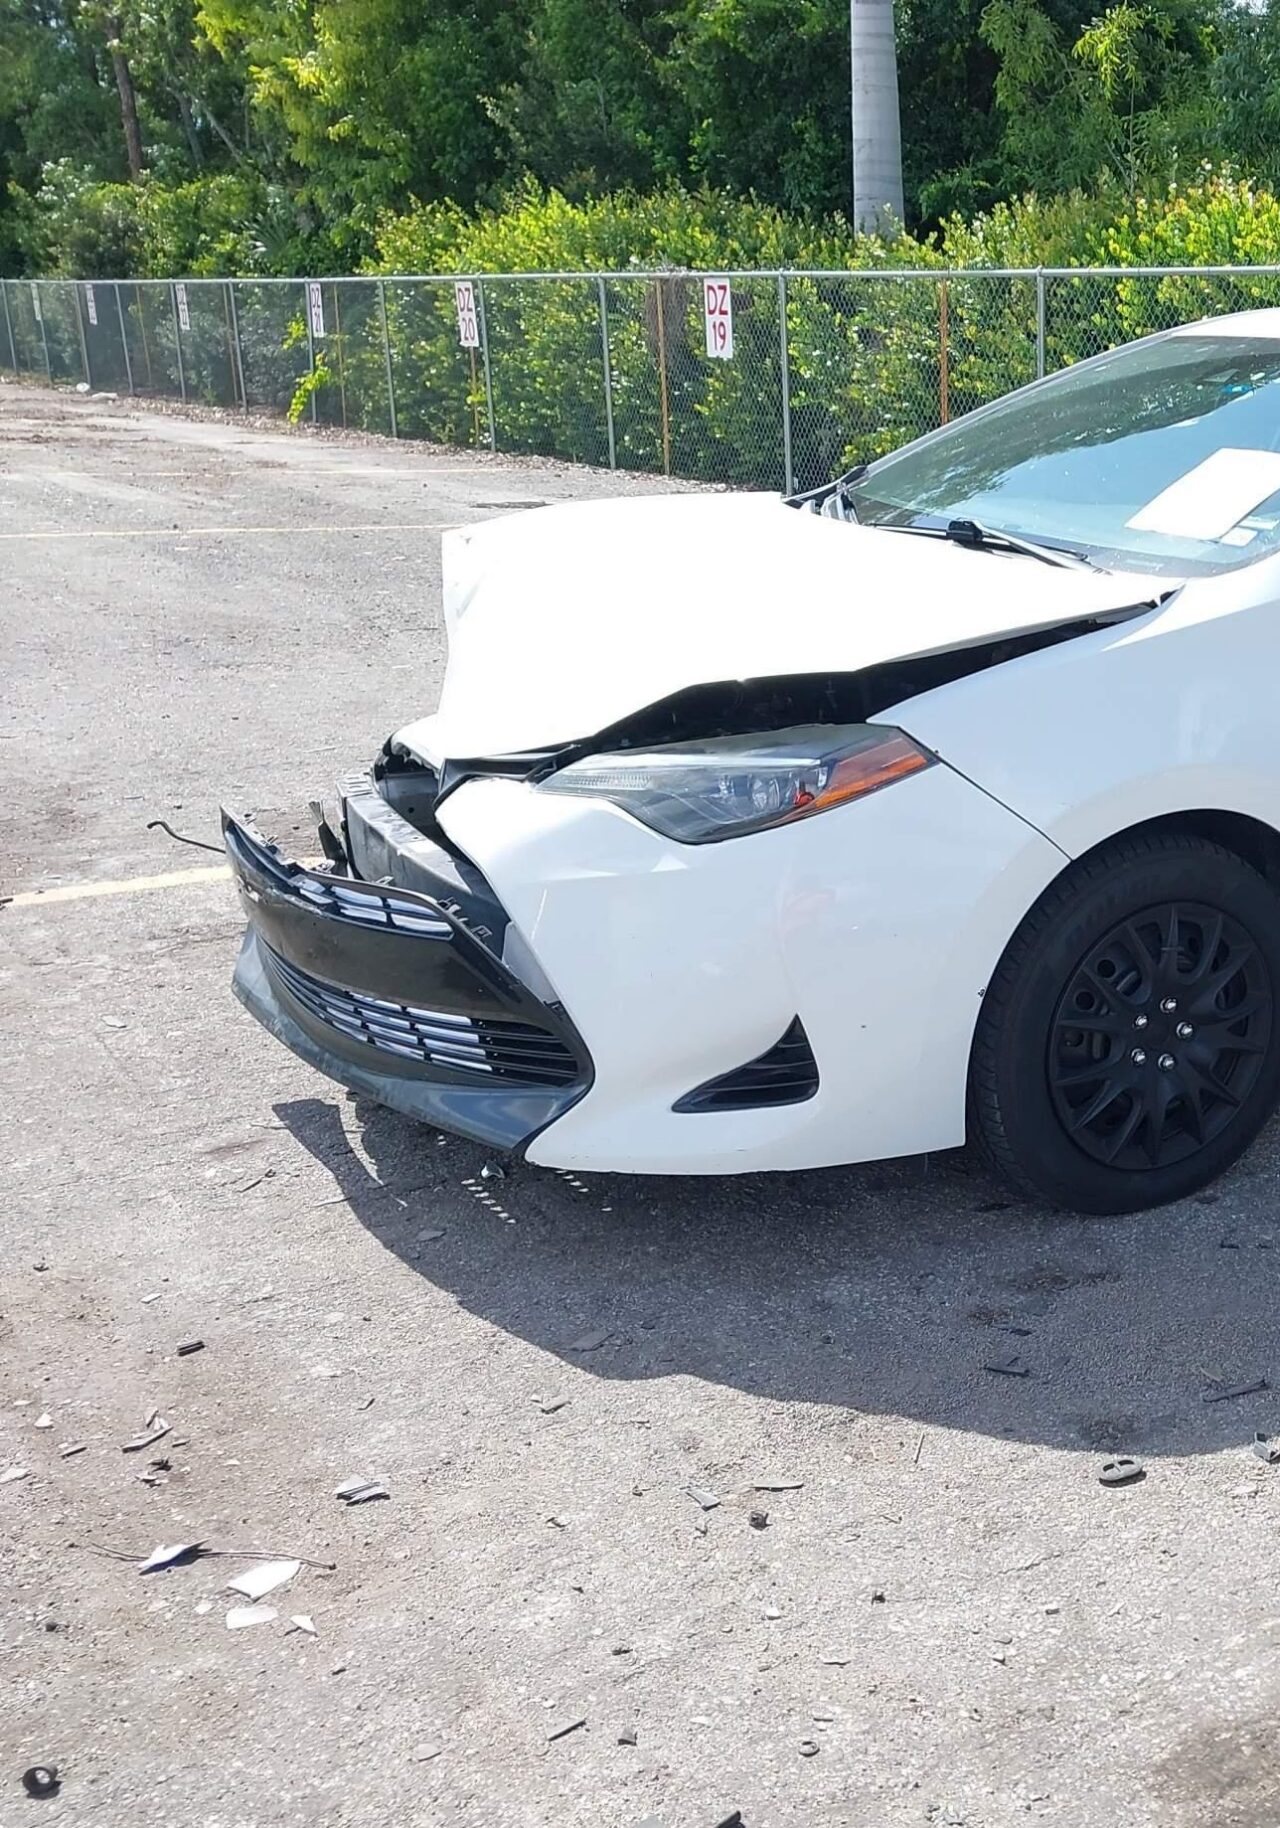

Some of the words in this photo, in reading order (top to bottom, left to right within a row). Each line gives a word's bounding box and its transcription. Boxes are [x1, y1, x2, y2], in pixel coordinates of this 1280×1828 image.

[458, 288, 473, 312] DZ
[707, 285, 728, 315] DZ
[462, 317, 475, 341] 20
[712, 321, 726, 350] 19
